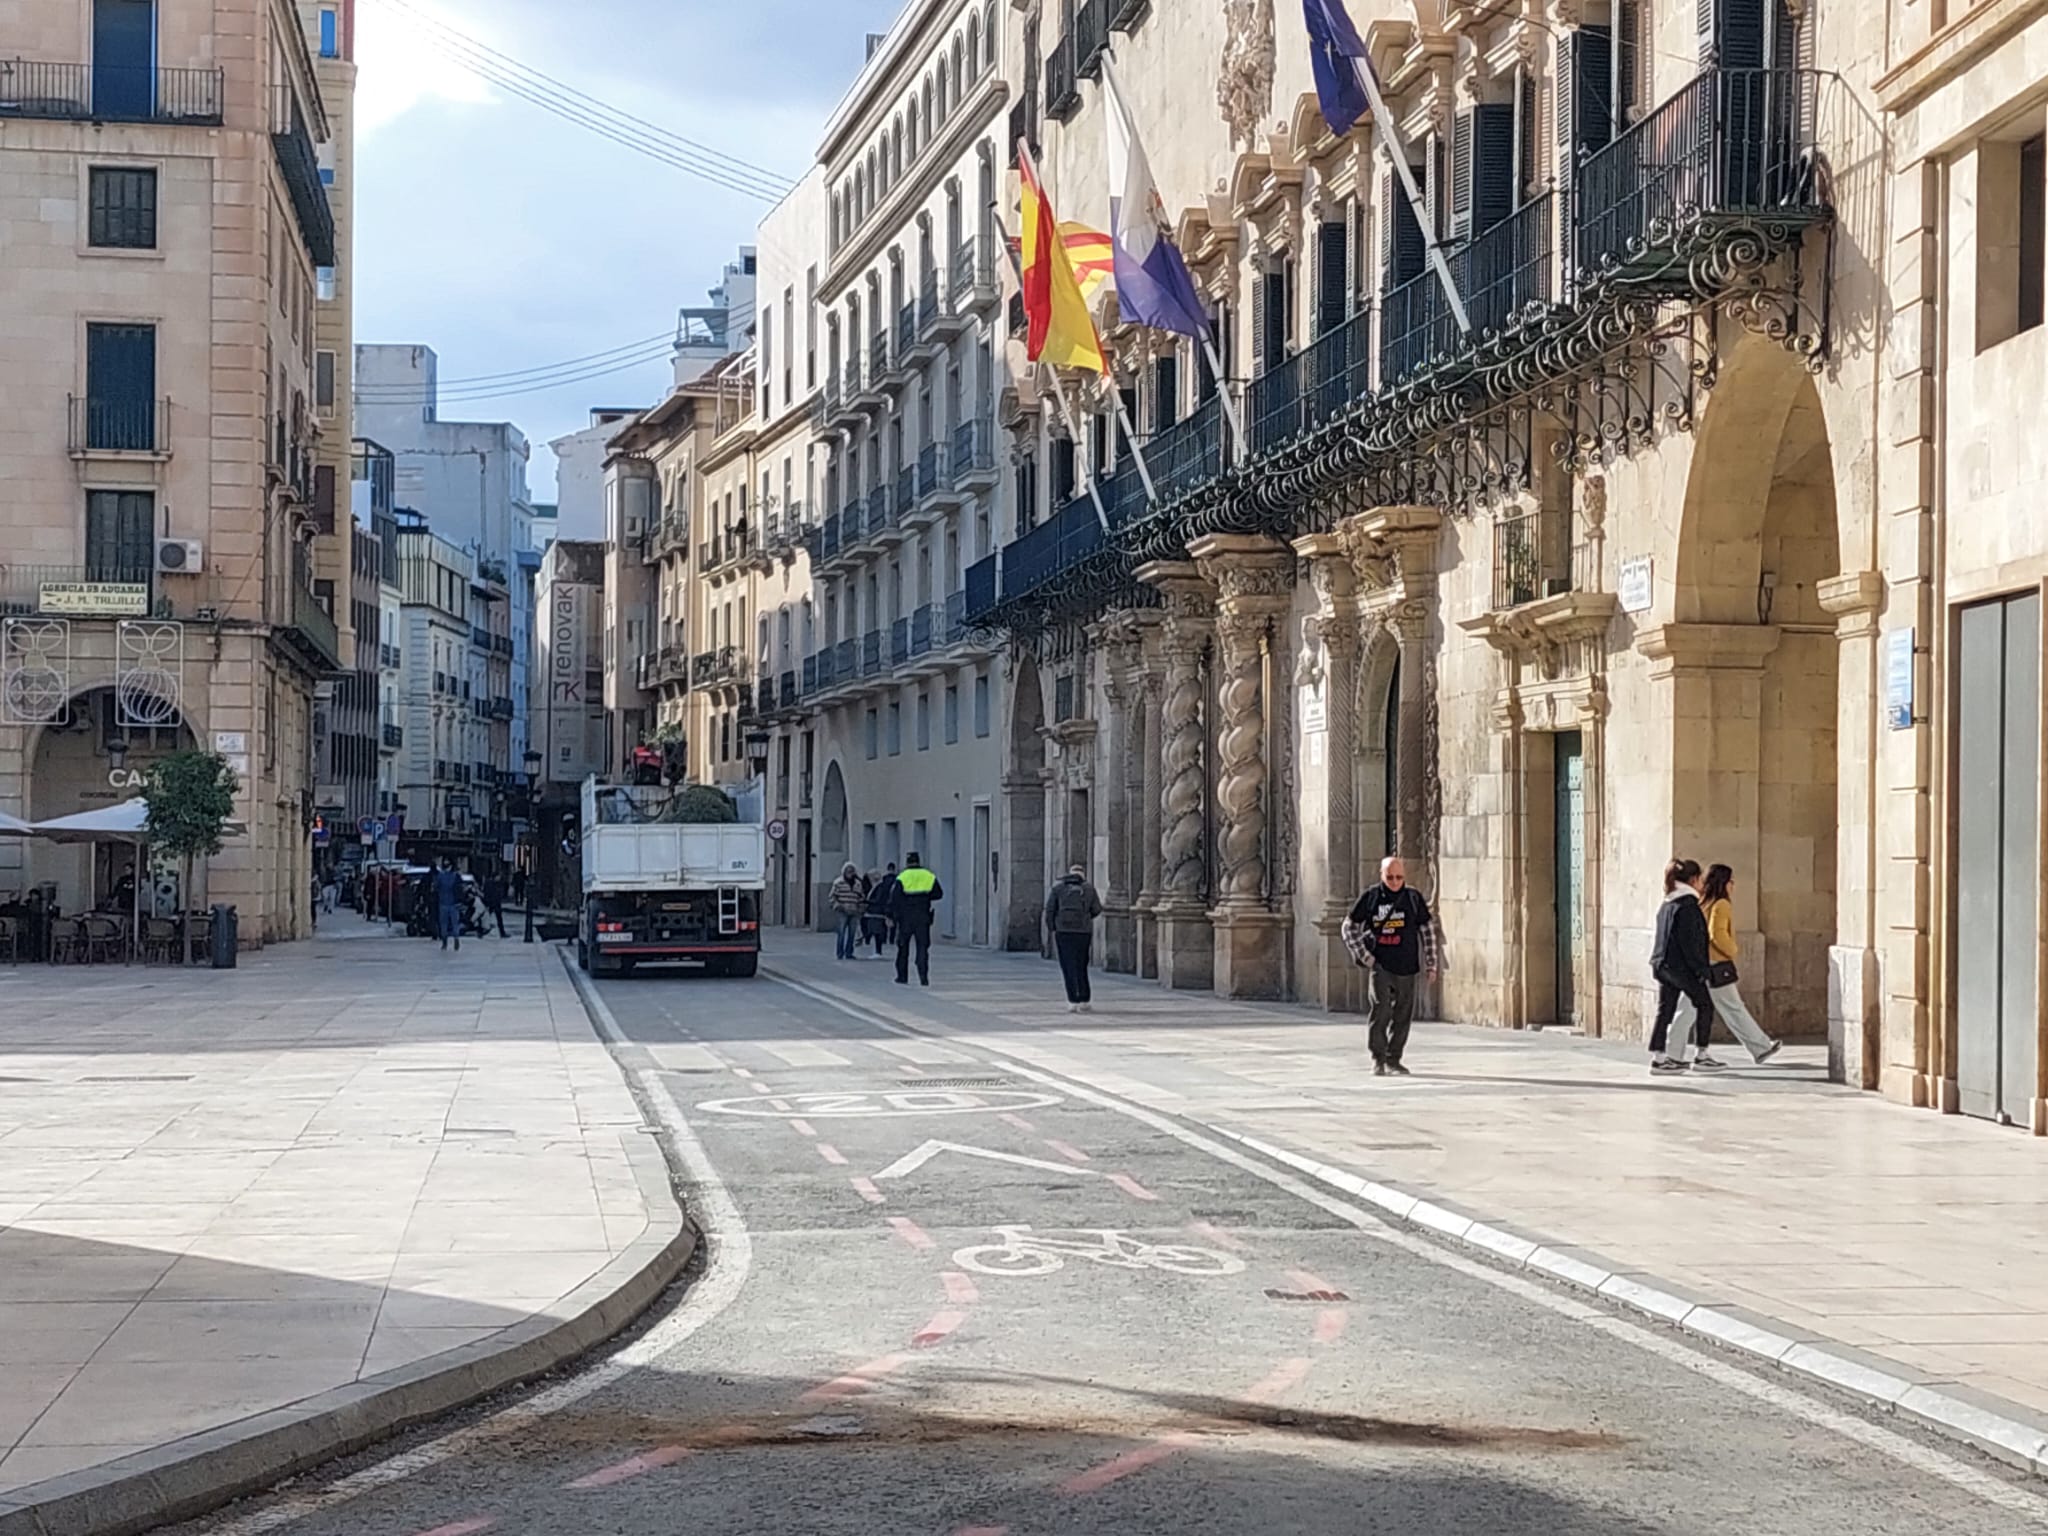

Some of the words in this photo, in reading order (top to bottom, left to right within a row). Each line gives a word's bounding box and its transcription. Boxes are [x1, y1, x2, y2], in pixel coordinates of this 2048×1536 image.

[41, 584, 85, 592] AGENCIA
[100, 586, 146, 594] ADUANAS
[556, 586, 573, 678] renovak
[375, 823, 384, 840] P
[796, 1094, 960, 1113] 20
